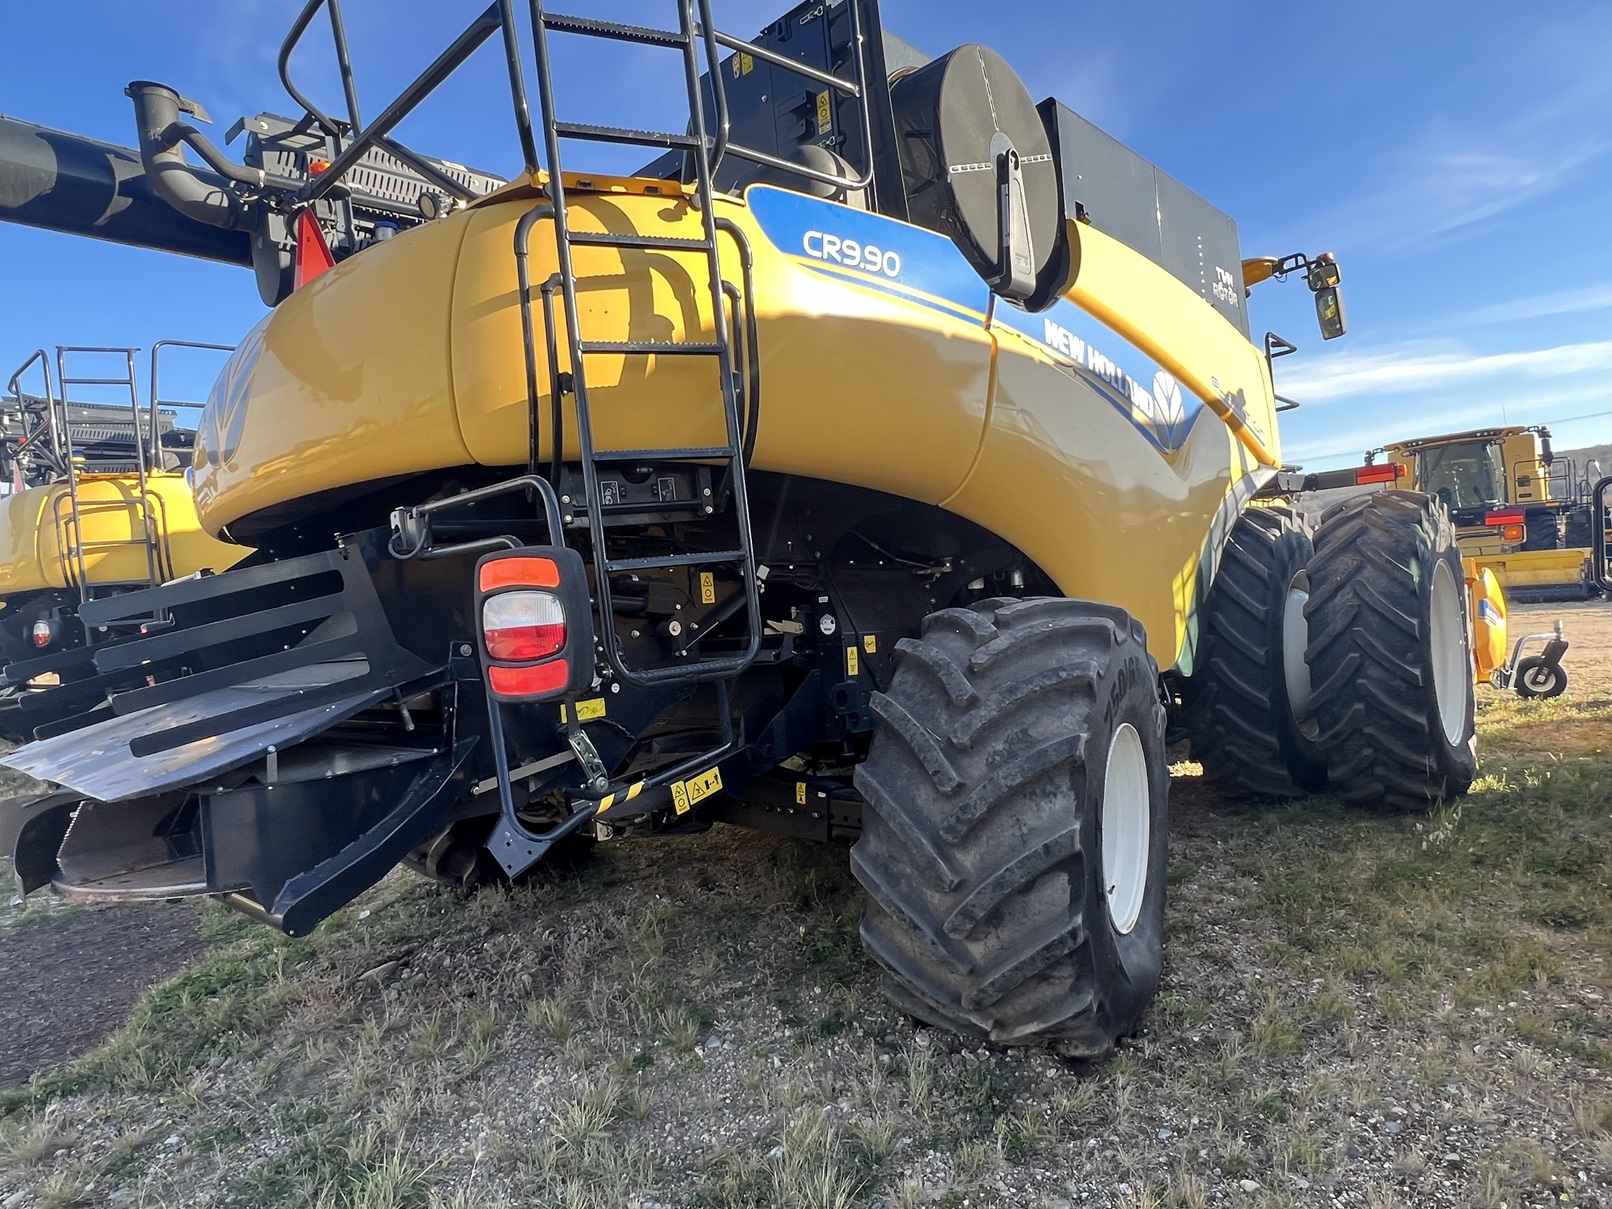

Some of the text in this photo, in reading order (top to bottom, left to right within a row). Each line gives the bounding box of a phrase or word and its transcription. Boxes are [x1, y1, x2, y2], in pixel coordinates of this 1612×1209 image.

[802, 230, 901, 278] CR9.90
[1044, 317, 1085, 364] NEW
[1087, 344, 1154, 419] HOLLAND
